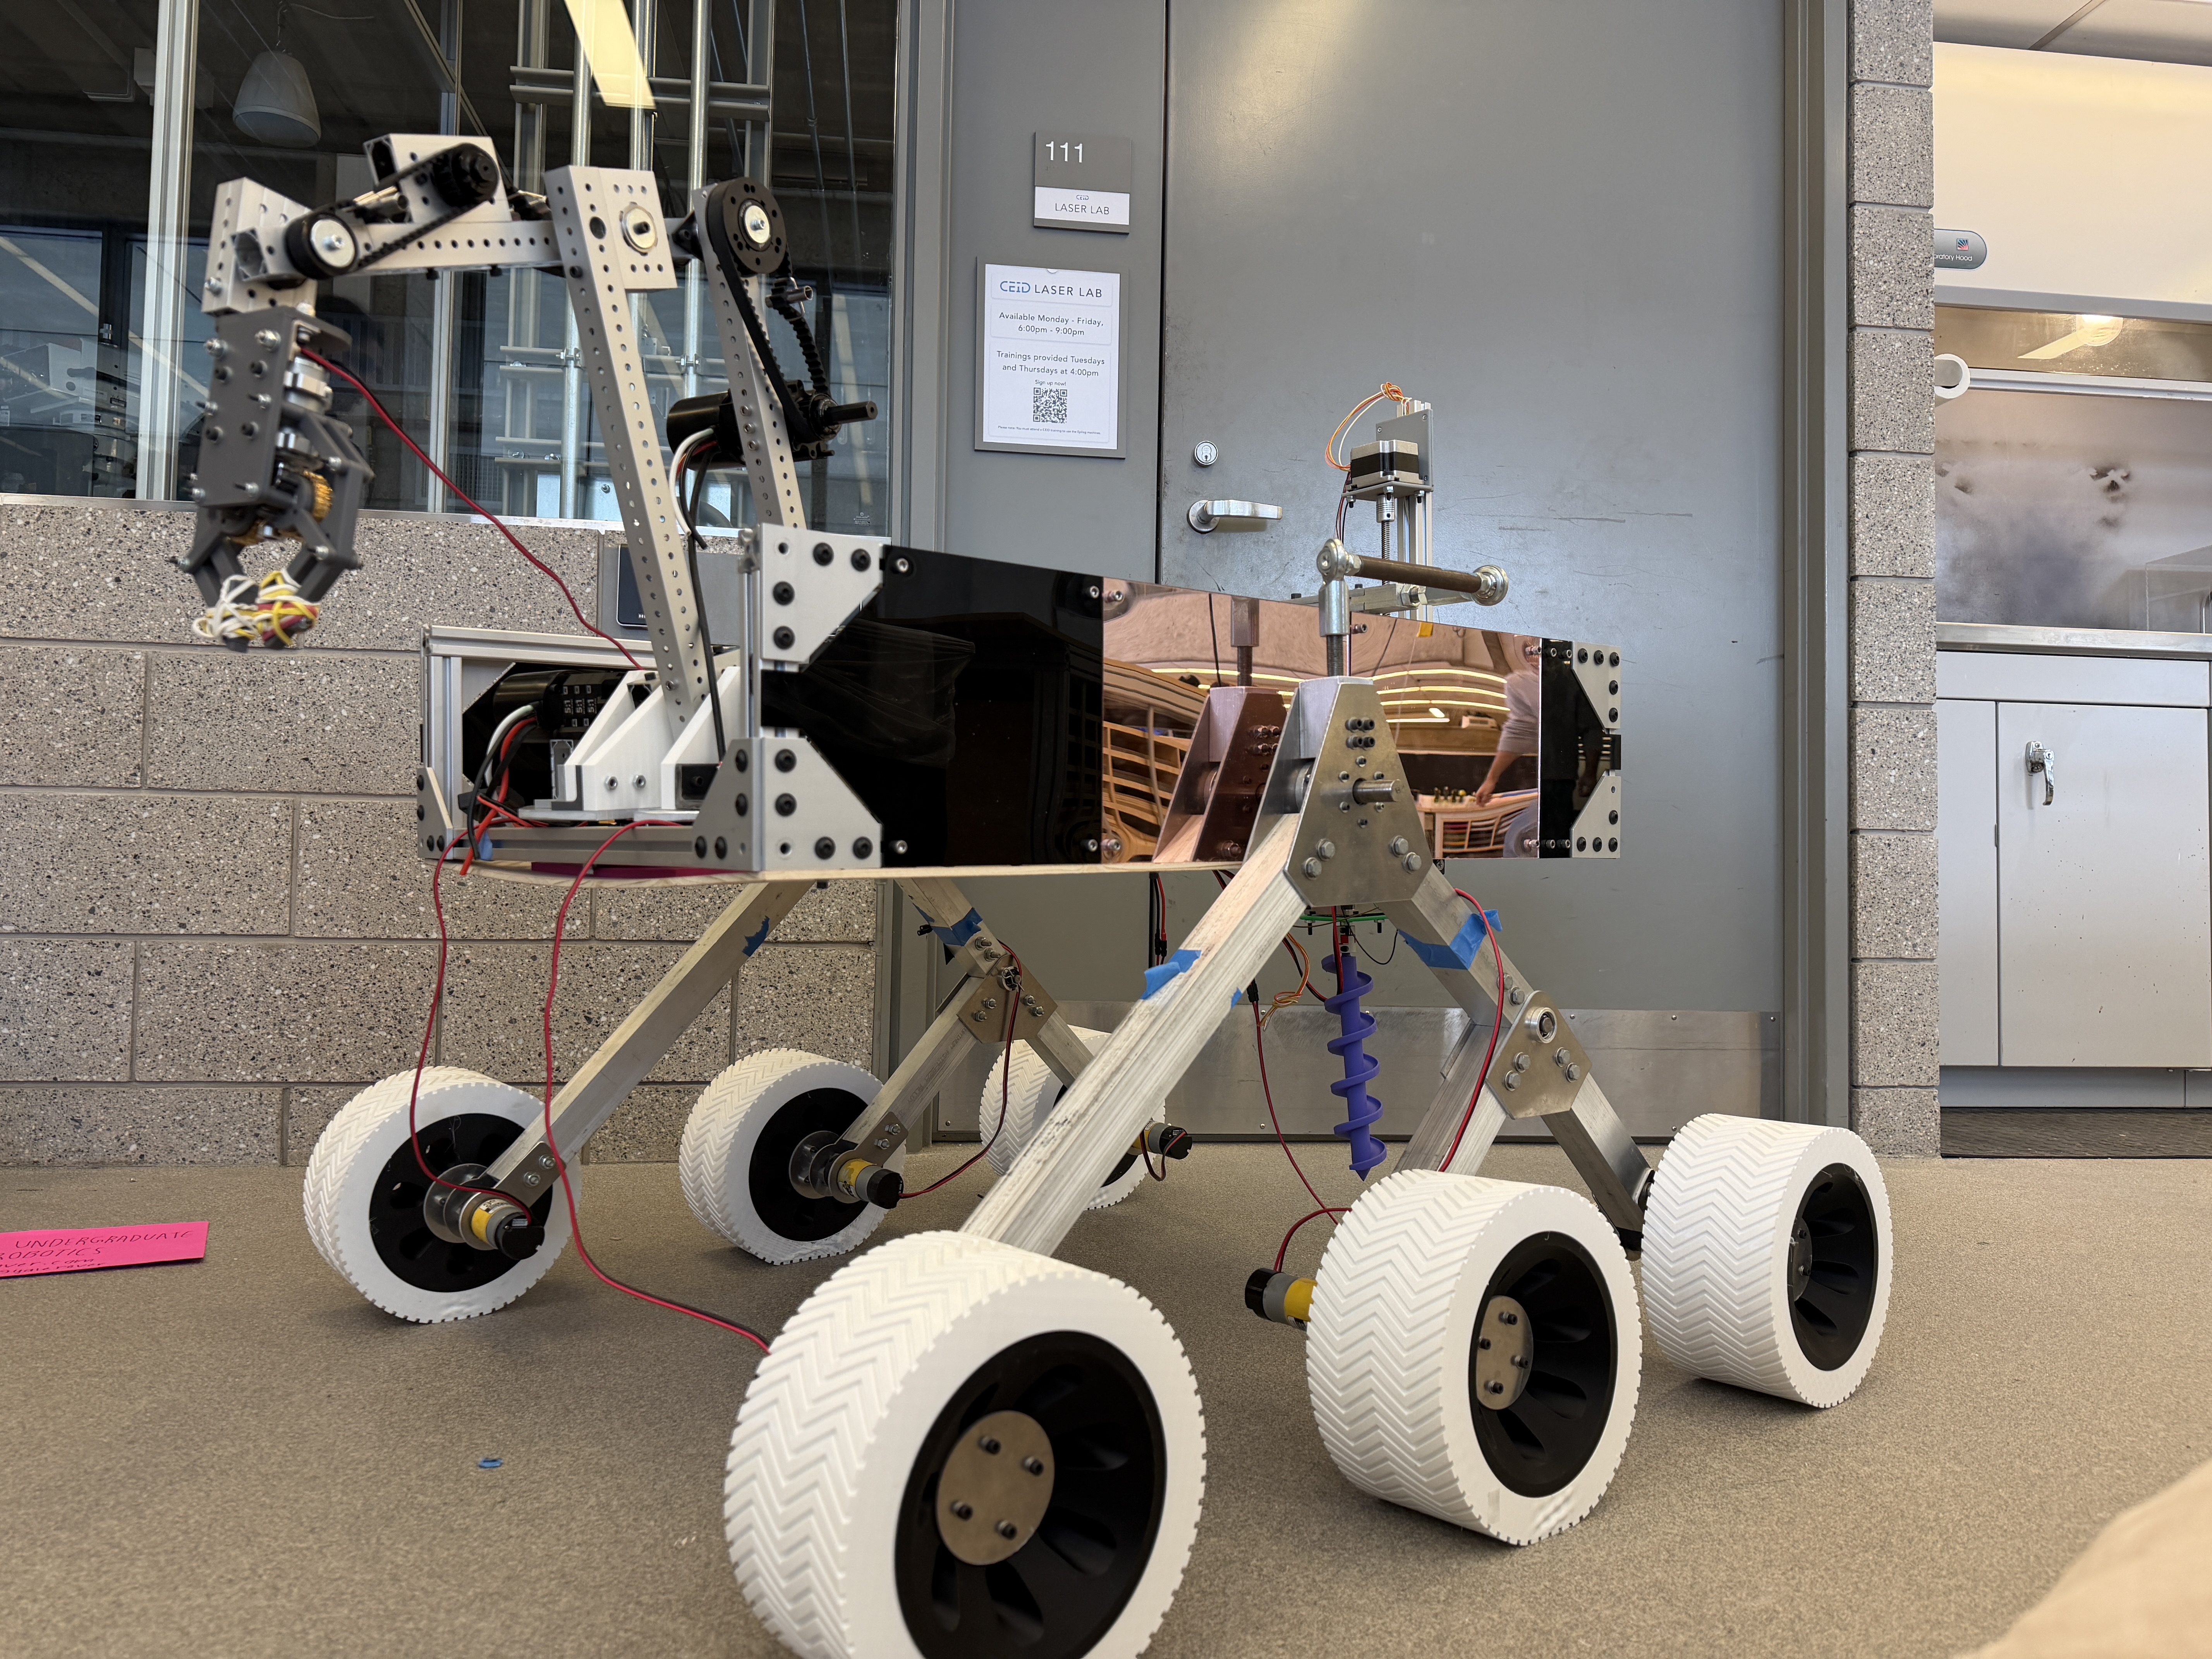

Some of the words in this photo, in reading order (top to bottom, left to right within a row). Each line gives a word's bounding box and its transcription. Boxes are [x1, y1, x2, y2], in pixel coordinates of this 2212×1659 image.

[1046, 141, 1082, 163] 111
[1055, 203, 1087, 213] LASER
[1091, 206, 1109, 215] LAB
[1000, 281, 1031, 293] CEID
[1035, 284, 1073, 296] LASER
[1079, 287, 1102, 297] LAB
[999, 312, 1035, 321] Available
[1038, 314, 1069, 325] Monday
[1077, 317, 1104, 327] Friday,
[1018, 325, 1047, 334] 6:00pm
[1055, 327, 1084, 337] 9:00pm
[997, 350, 1031, 361] Trainings
[1070, 356, 1105, 366] Tuesdays
[1019, 365, 1058, 375] Thursdays
[1070, 368, 1099, 378] 4:00pm
[16, 1231, 193, 1248] UNDERGRADUATE
[0, 1259, 94, 1267] ver.com
